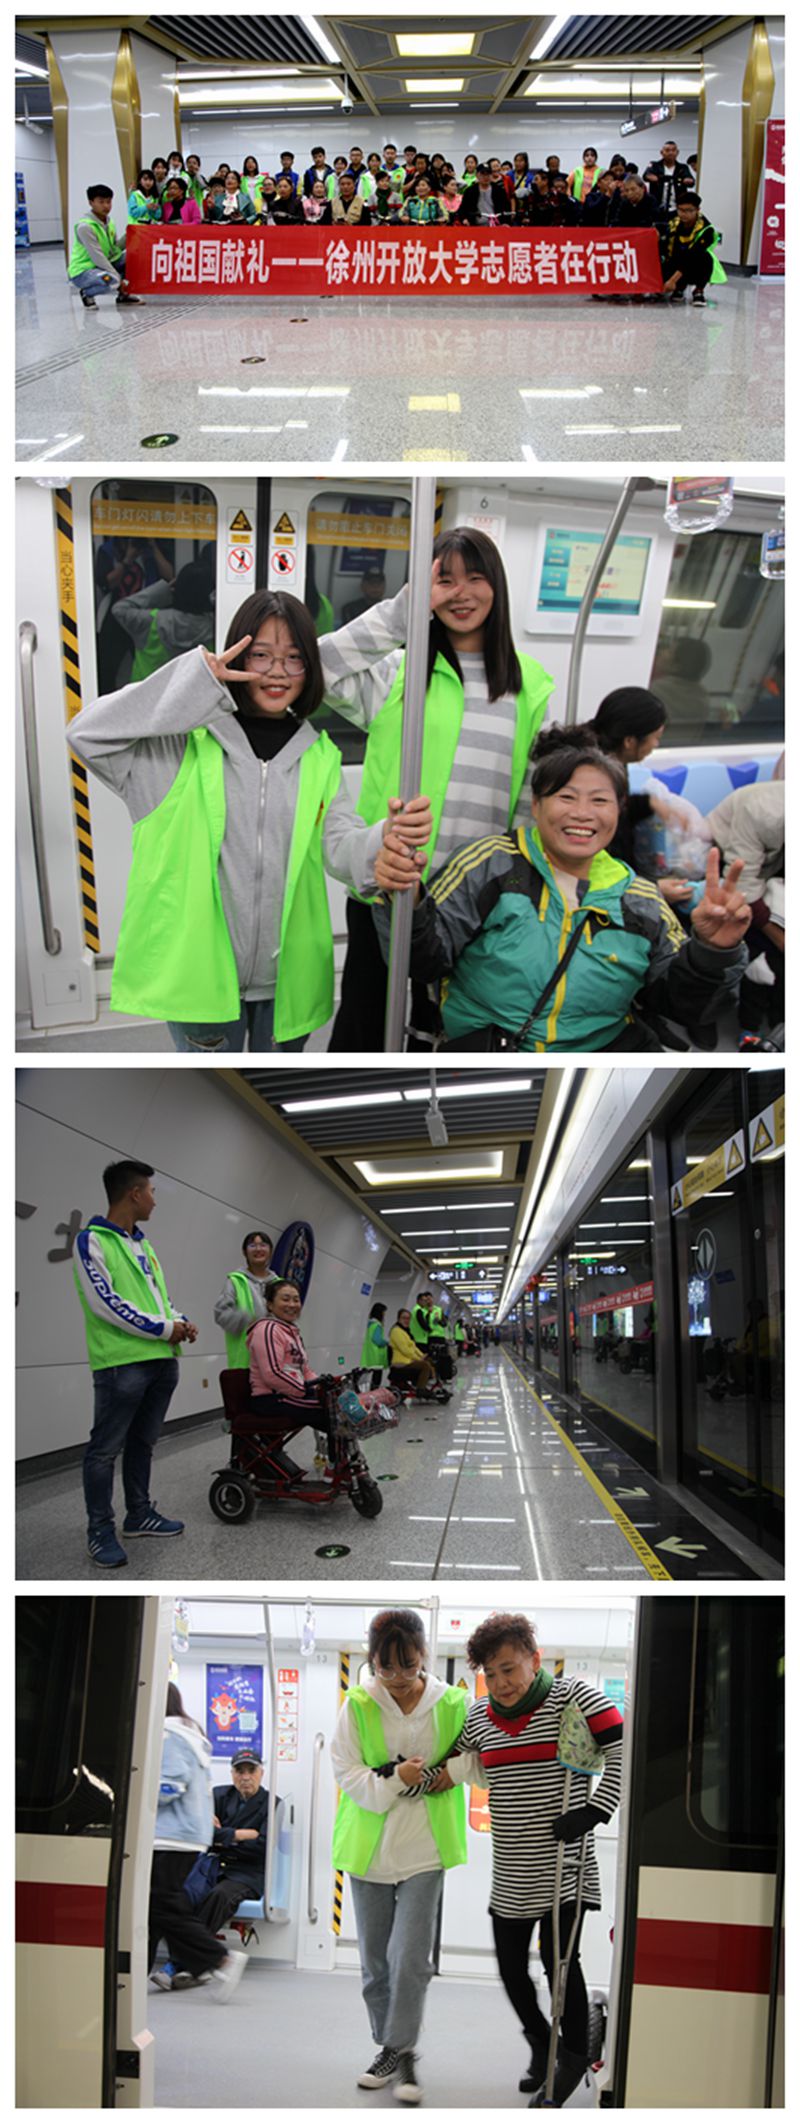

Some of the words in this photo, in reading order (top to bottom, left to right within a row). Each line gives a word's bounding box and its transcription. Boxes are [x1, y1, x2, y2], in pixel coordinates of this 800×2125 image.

[151, 238, 640, 285] 向祖国献礼——徐州开放大学志愿者在行动
[480, 496, 489, 510] 6
[60, 550, 75, 604] 当心夹手
[316, 1654, 328, 1664] 13
